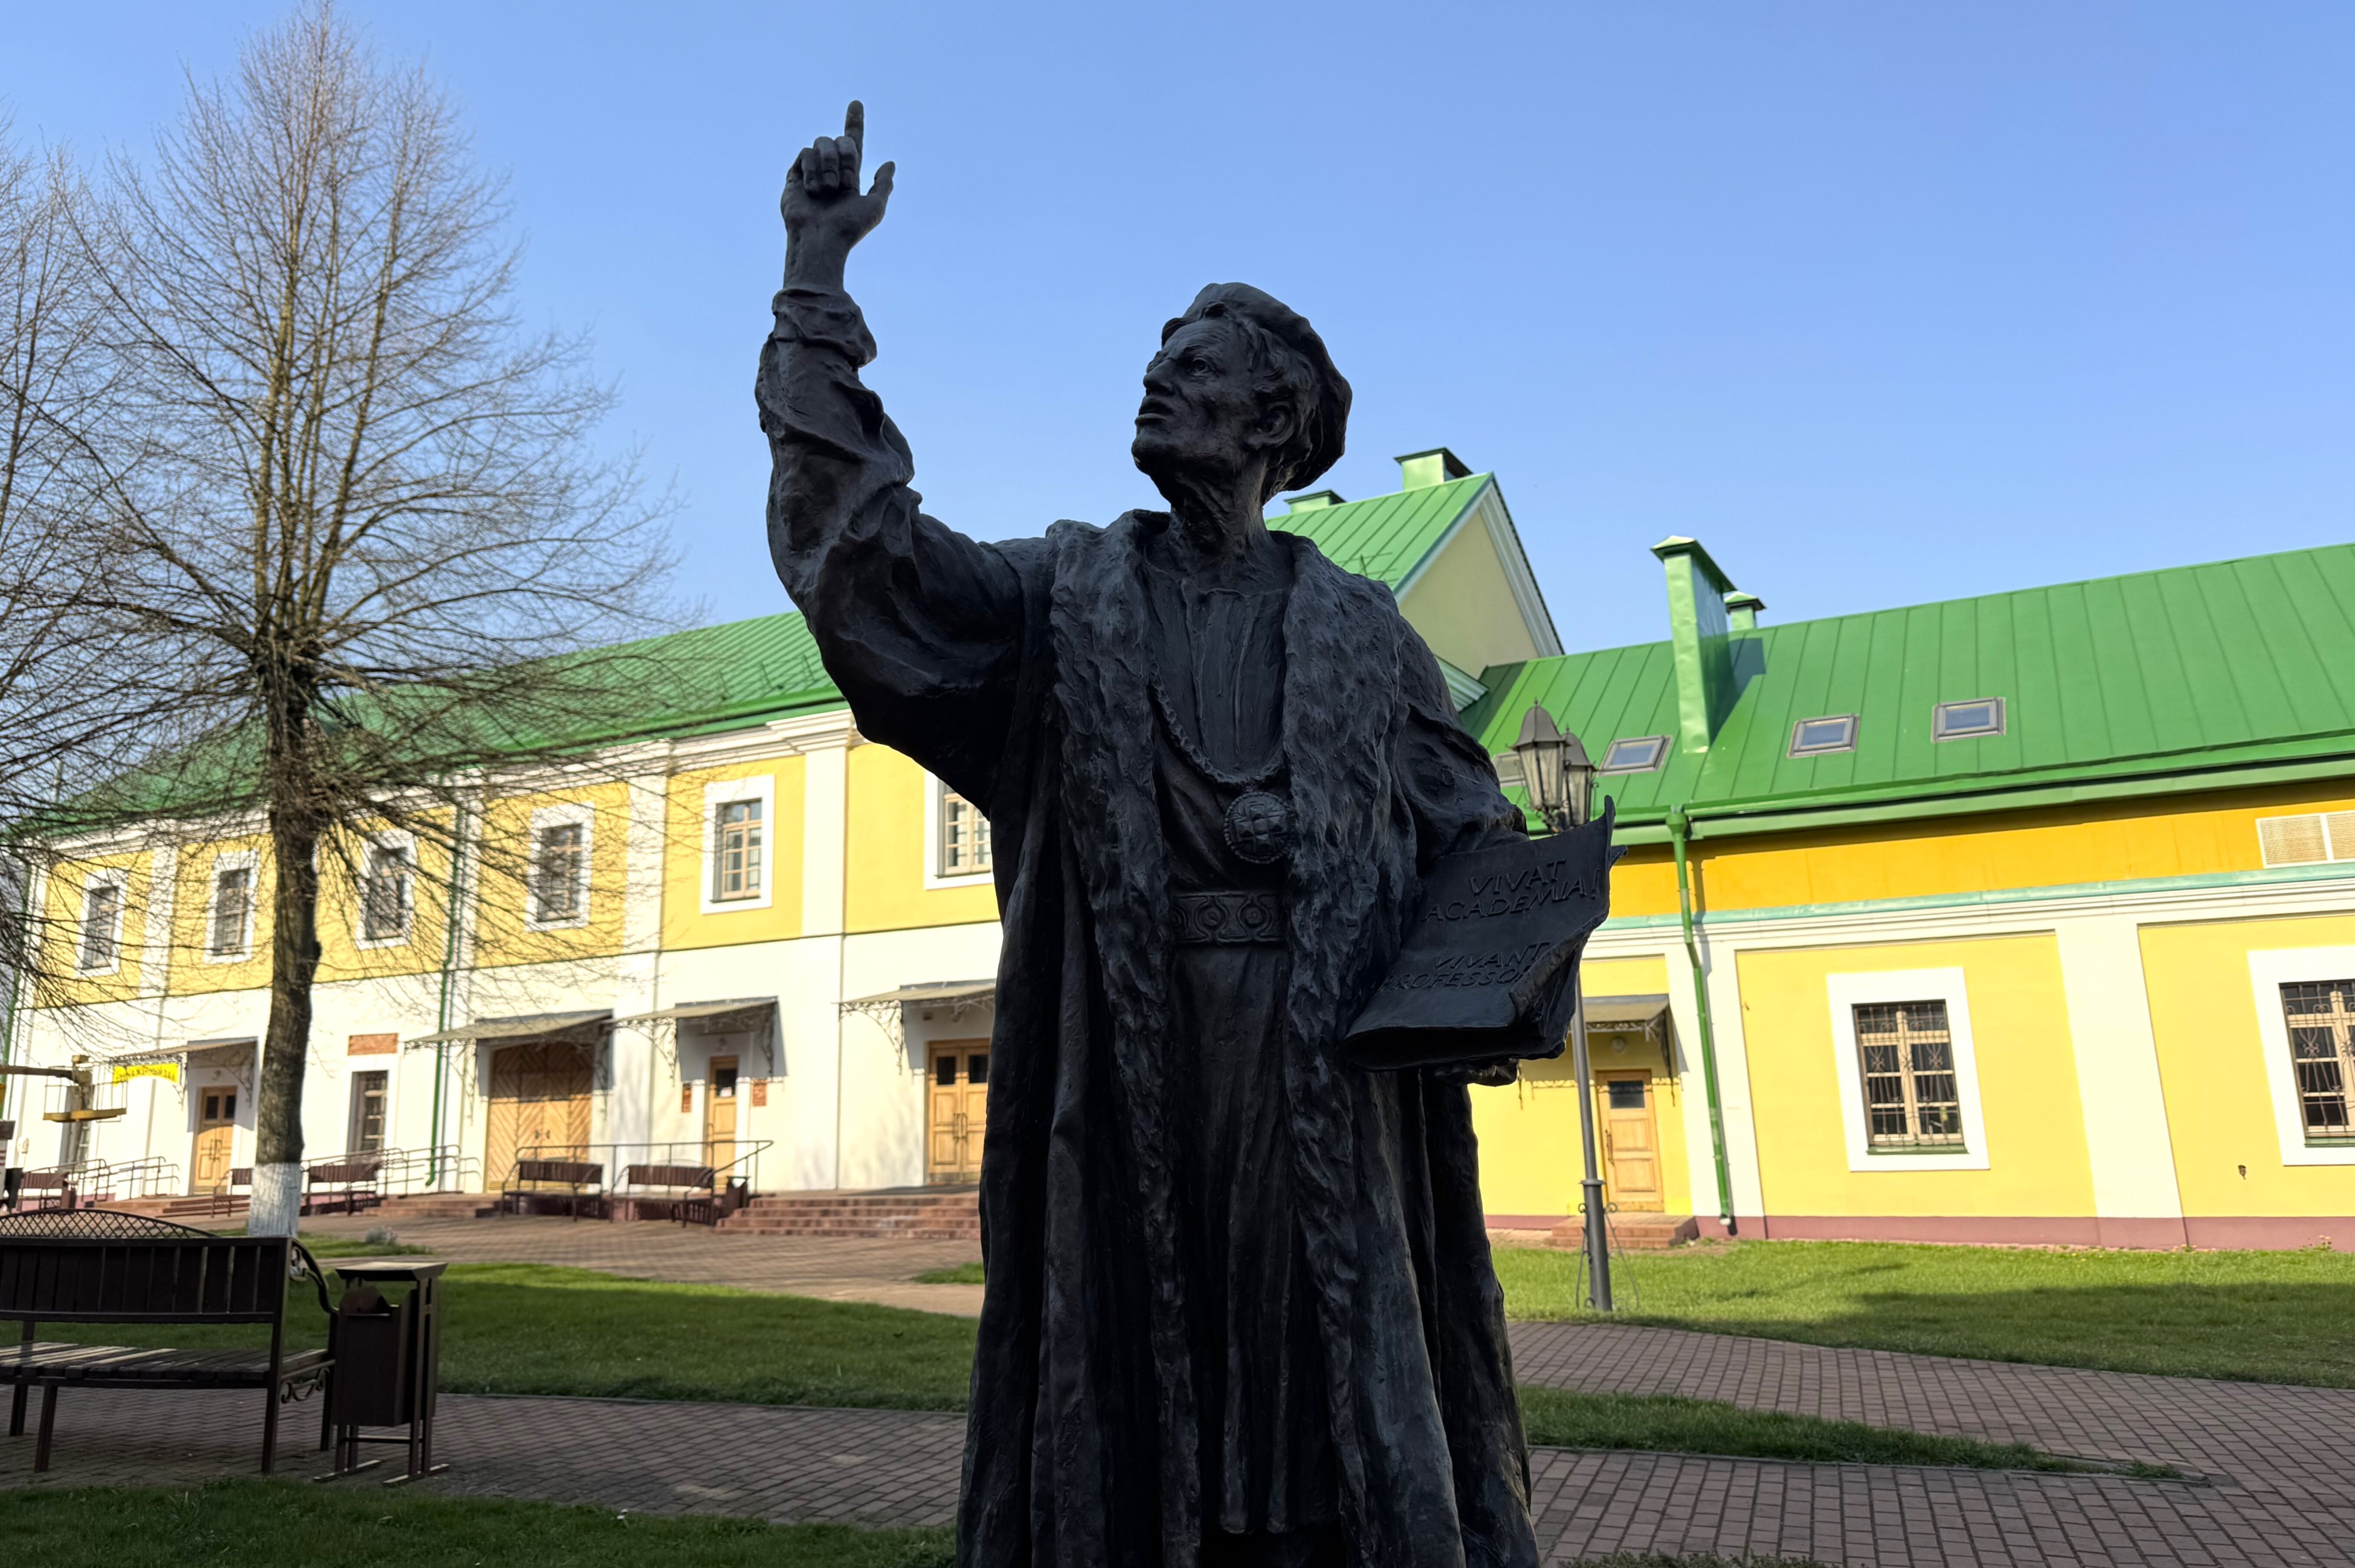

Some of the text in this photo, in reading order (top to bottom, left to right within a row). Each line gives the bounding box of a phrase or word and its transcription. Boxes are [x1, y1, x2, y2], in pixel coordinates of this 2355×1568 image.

[1421, 867, 1601, 922] ACADEMIA!
[1469, 858, 1567, 896] VIVAT
[1435, 942, 1551, 970] VIVANT
